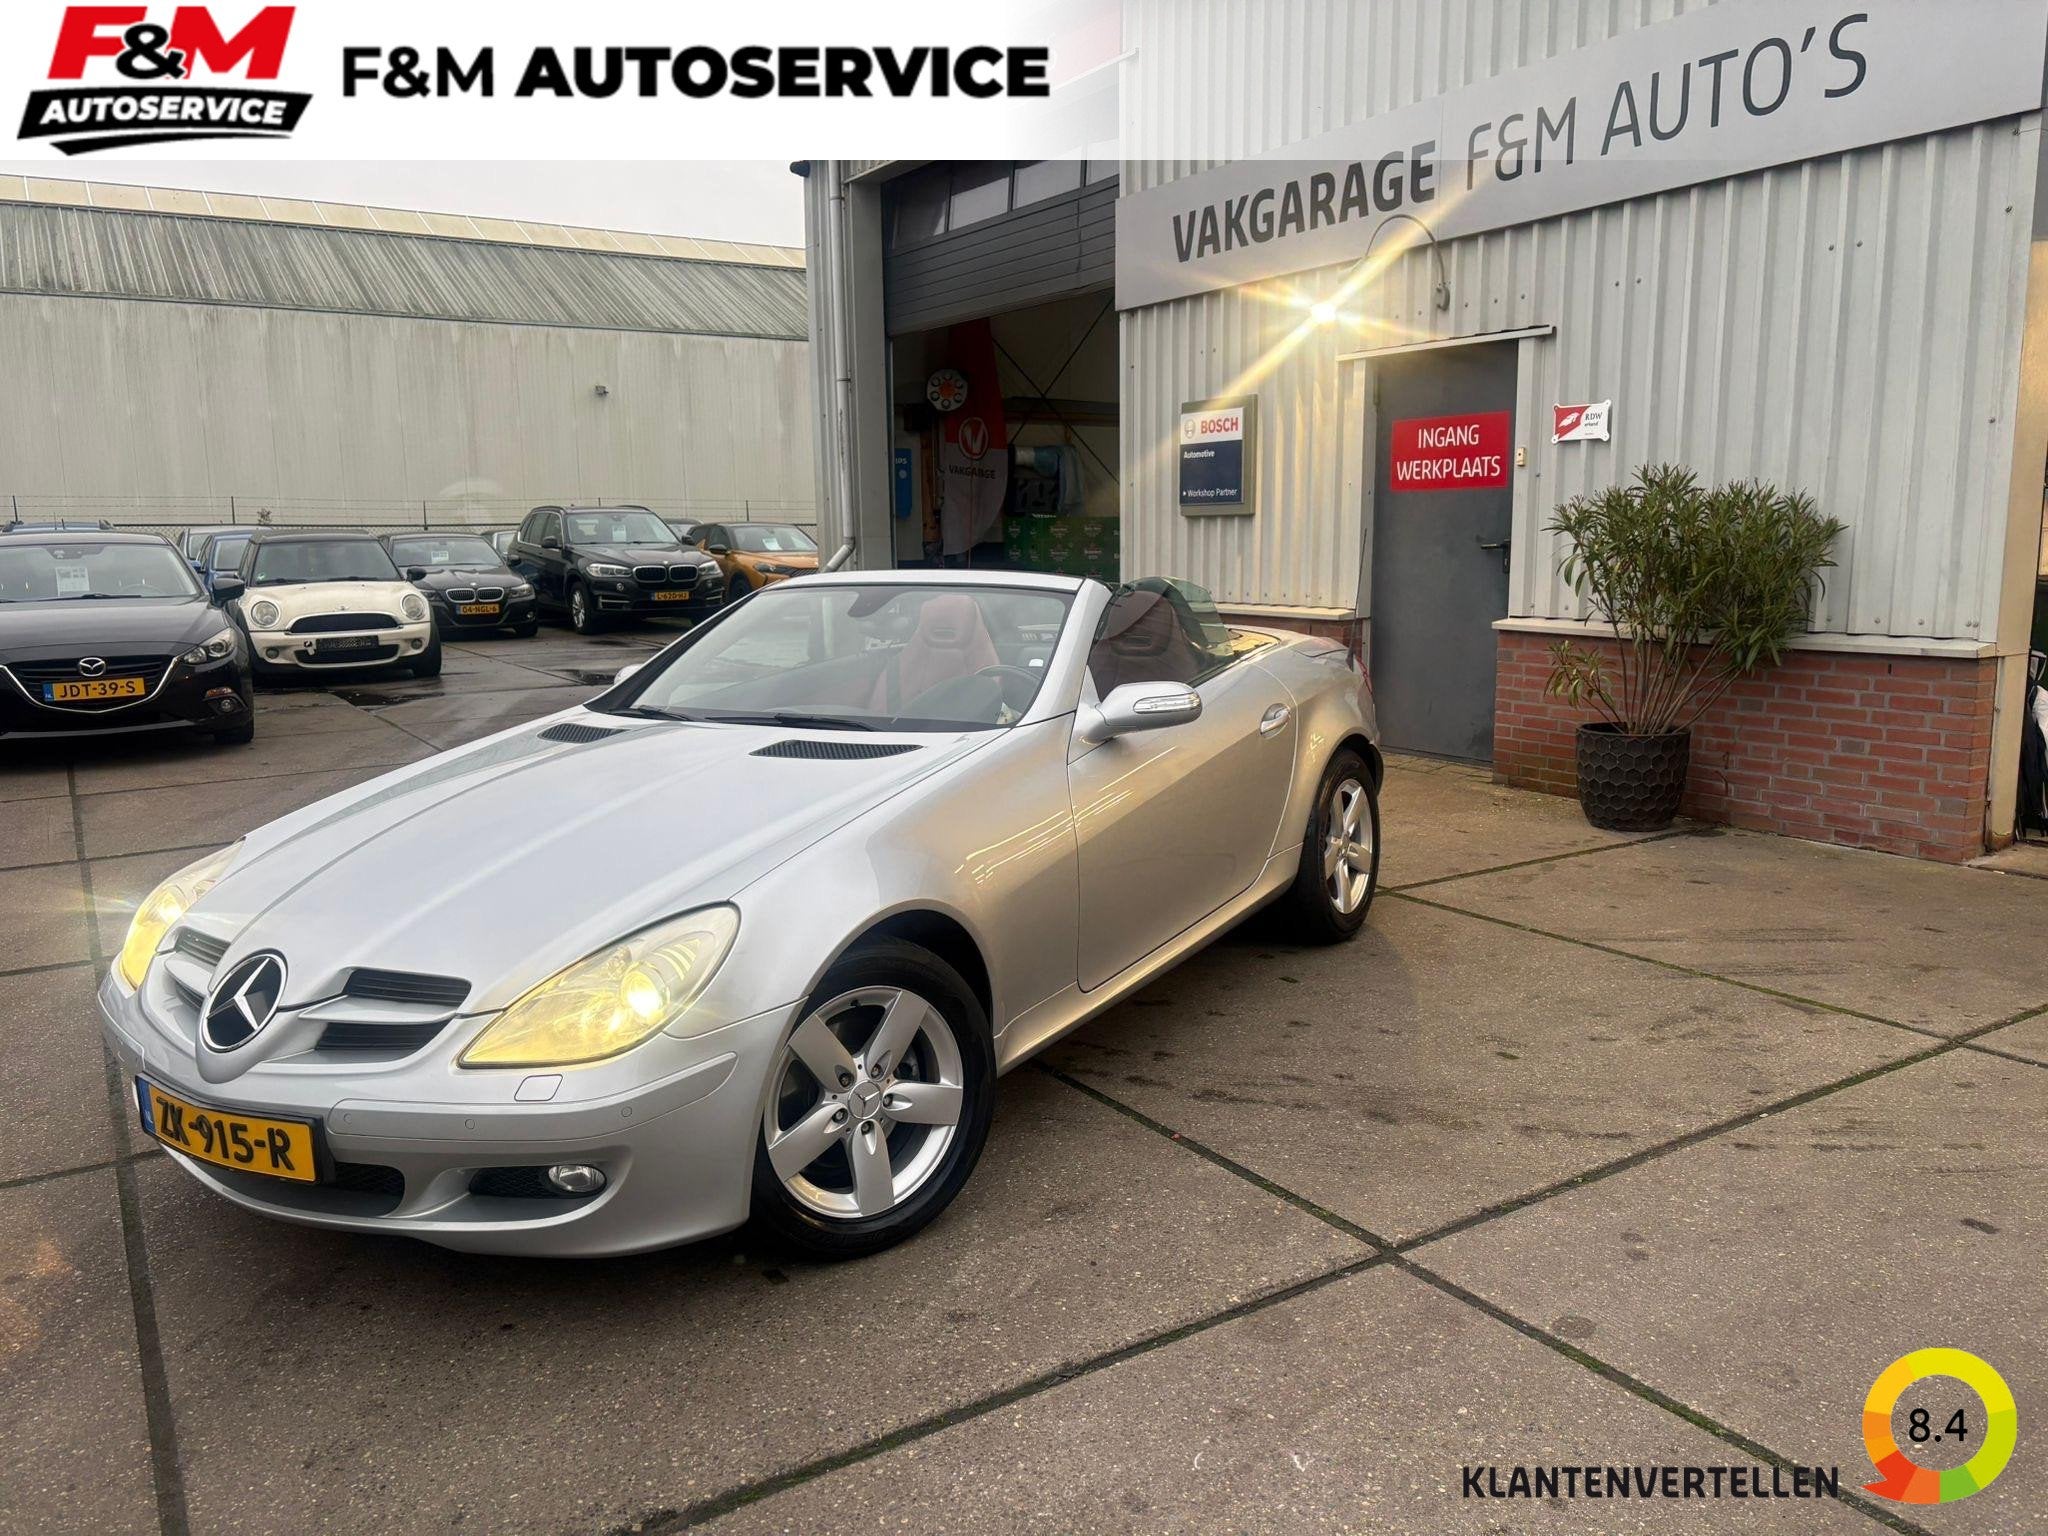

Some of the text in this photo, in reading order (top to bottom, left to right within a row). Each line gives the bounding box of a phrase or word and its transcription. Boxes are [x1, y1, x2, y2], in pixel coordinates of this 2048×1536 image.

[1172, 13, 1869, 263] VAKGARAGE F&M AUTO'S
[1585, 411, 1603, 421] RDW
[1200, 417, 1239, 434] BOSCH
[1418, 424, 1480, 449] INGANG
[1183, 449, 1215, 459] Automotive
[948, 464, 997, 479] VAKGARAGE
[1397, 456, 1501, 481] WERKPLAATS
[1187, 488, 1238, 498] Workshop Partner
[60, 681, 135, 698] JDT-39-S
[155, 1096, 296, 1171] ZK-915-R
